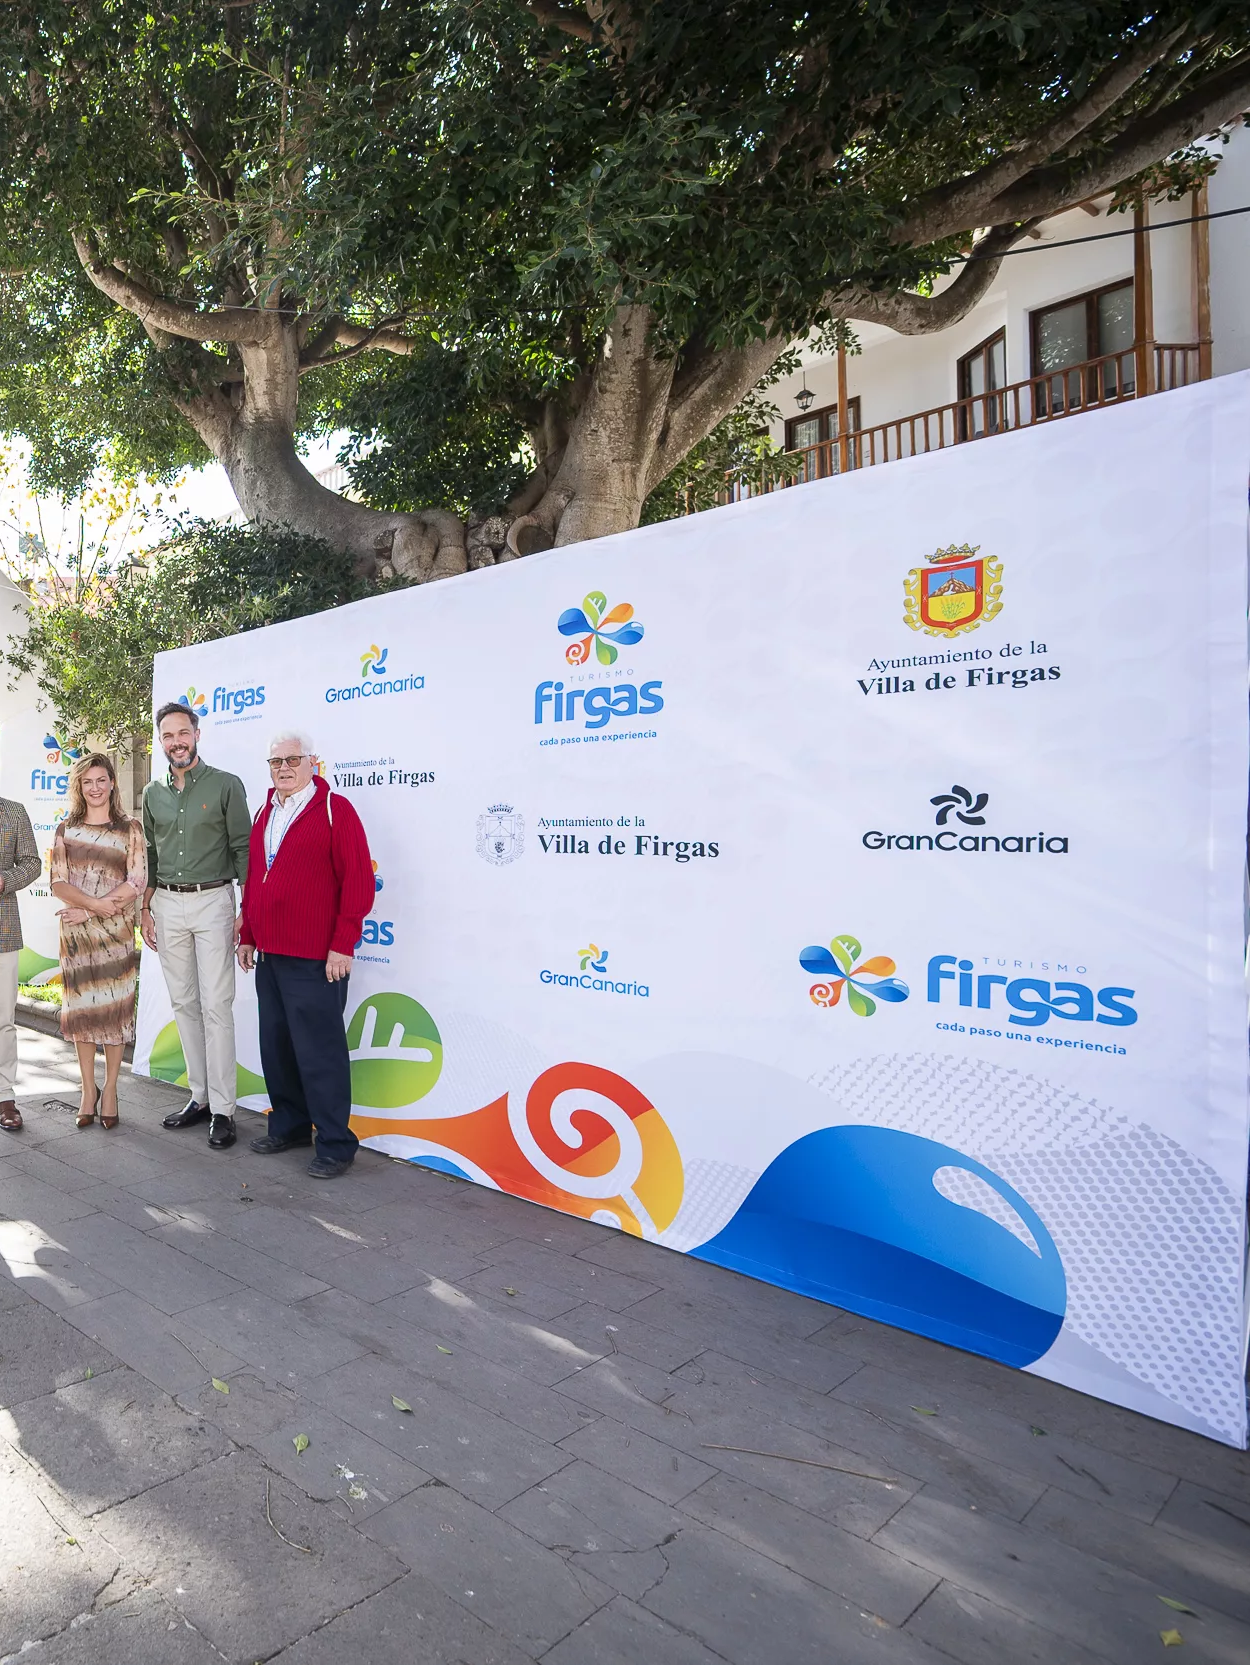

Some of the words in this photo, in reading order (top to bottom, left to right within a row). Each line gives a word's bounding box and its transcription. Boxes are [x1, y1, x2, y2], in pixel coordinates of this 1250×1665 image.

[867, 648, 993, 673] Ayuntamiento
[999, 643, 1023, 658] de
[1030, 640, 1048, 655] la
[325, 673, 425, 703] GranCanaria
[569, 668, 635, 683] TURISMO
[857, 676, 916, 696] Villa
[925, 672, 957, 691] de
[965, 665, 1062, 689] Firgas
[212, 685, 266, 715] firgas
[534, 680, 665, 729] firgas
[539, 737, 559, 746] cada
[560, 736, 582, 746] paso
[583, 735, 600, 743] una
[601, 730, 657, 742] experiencia
[333, 759, 377, 771] Ayuntamiento
[378, 757, 387, 766] de
[388, 756, 395, 765] la
[31, 768, 69, 795] firg
[333, 773, 363, 788] Villa
[367, 771, 384, 786] de
[388, 769, 436, 788] Firgas
[537, 816, 614, 829] Ayuntamiento
[616, 816, 631, 827] de
[634, 816, 646, 827] la
[537, 834, 590, 854] Villa
[597, 835, 626, 855] de
[634, 834, 720, 864] Firgas
[862, 830, 1069, 854] GranCanaria
[356, 954, 390, 964] experiencia
[982, 956, 1088, 975] TURISMO
[539, 969, 650, 998] GranCanaria
[927, 954, 1138, 1027] firgas
[935, 1020, 966, 1033] cada
[969, 1026, 1002, 1038] paso
[1006, 1031, 1032, 1042] una
[1036, 1035, 1127, 1056] experiencia
